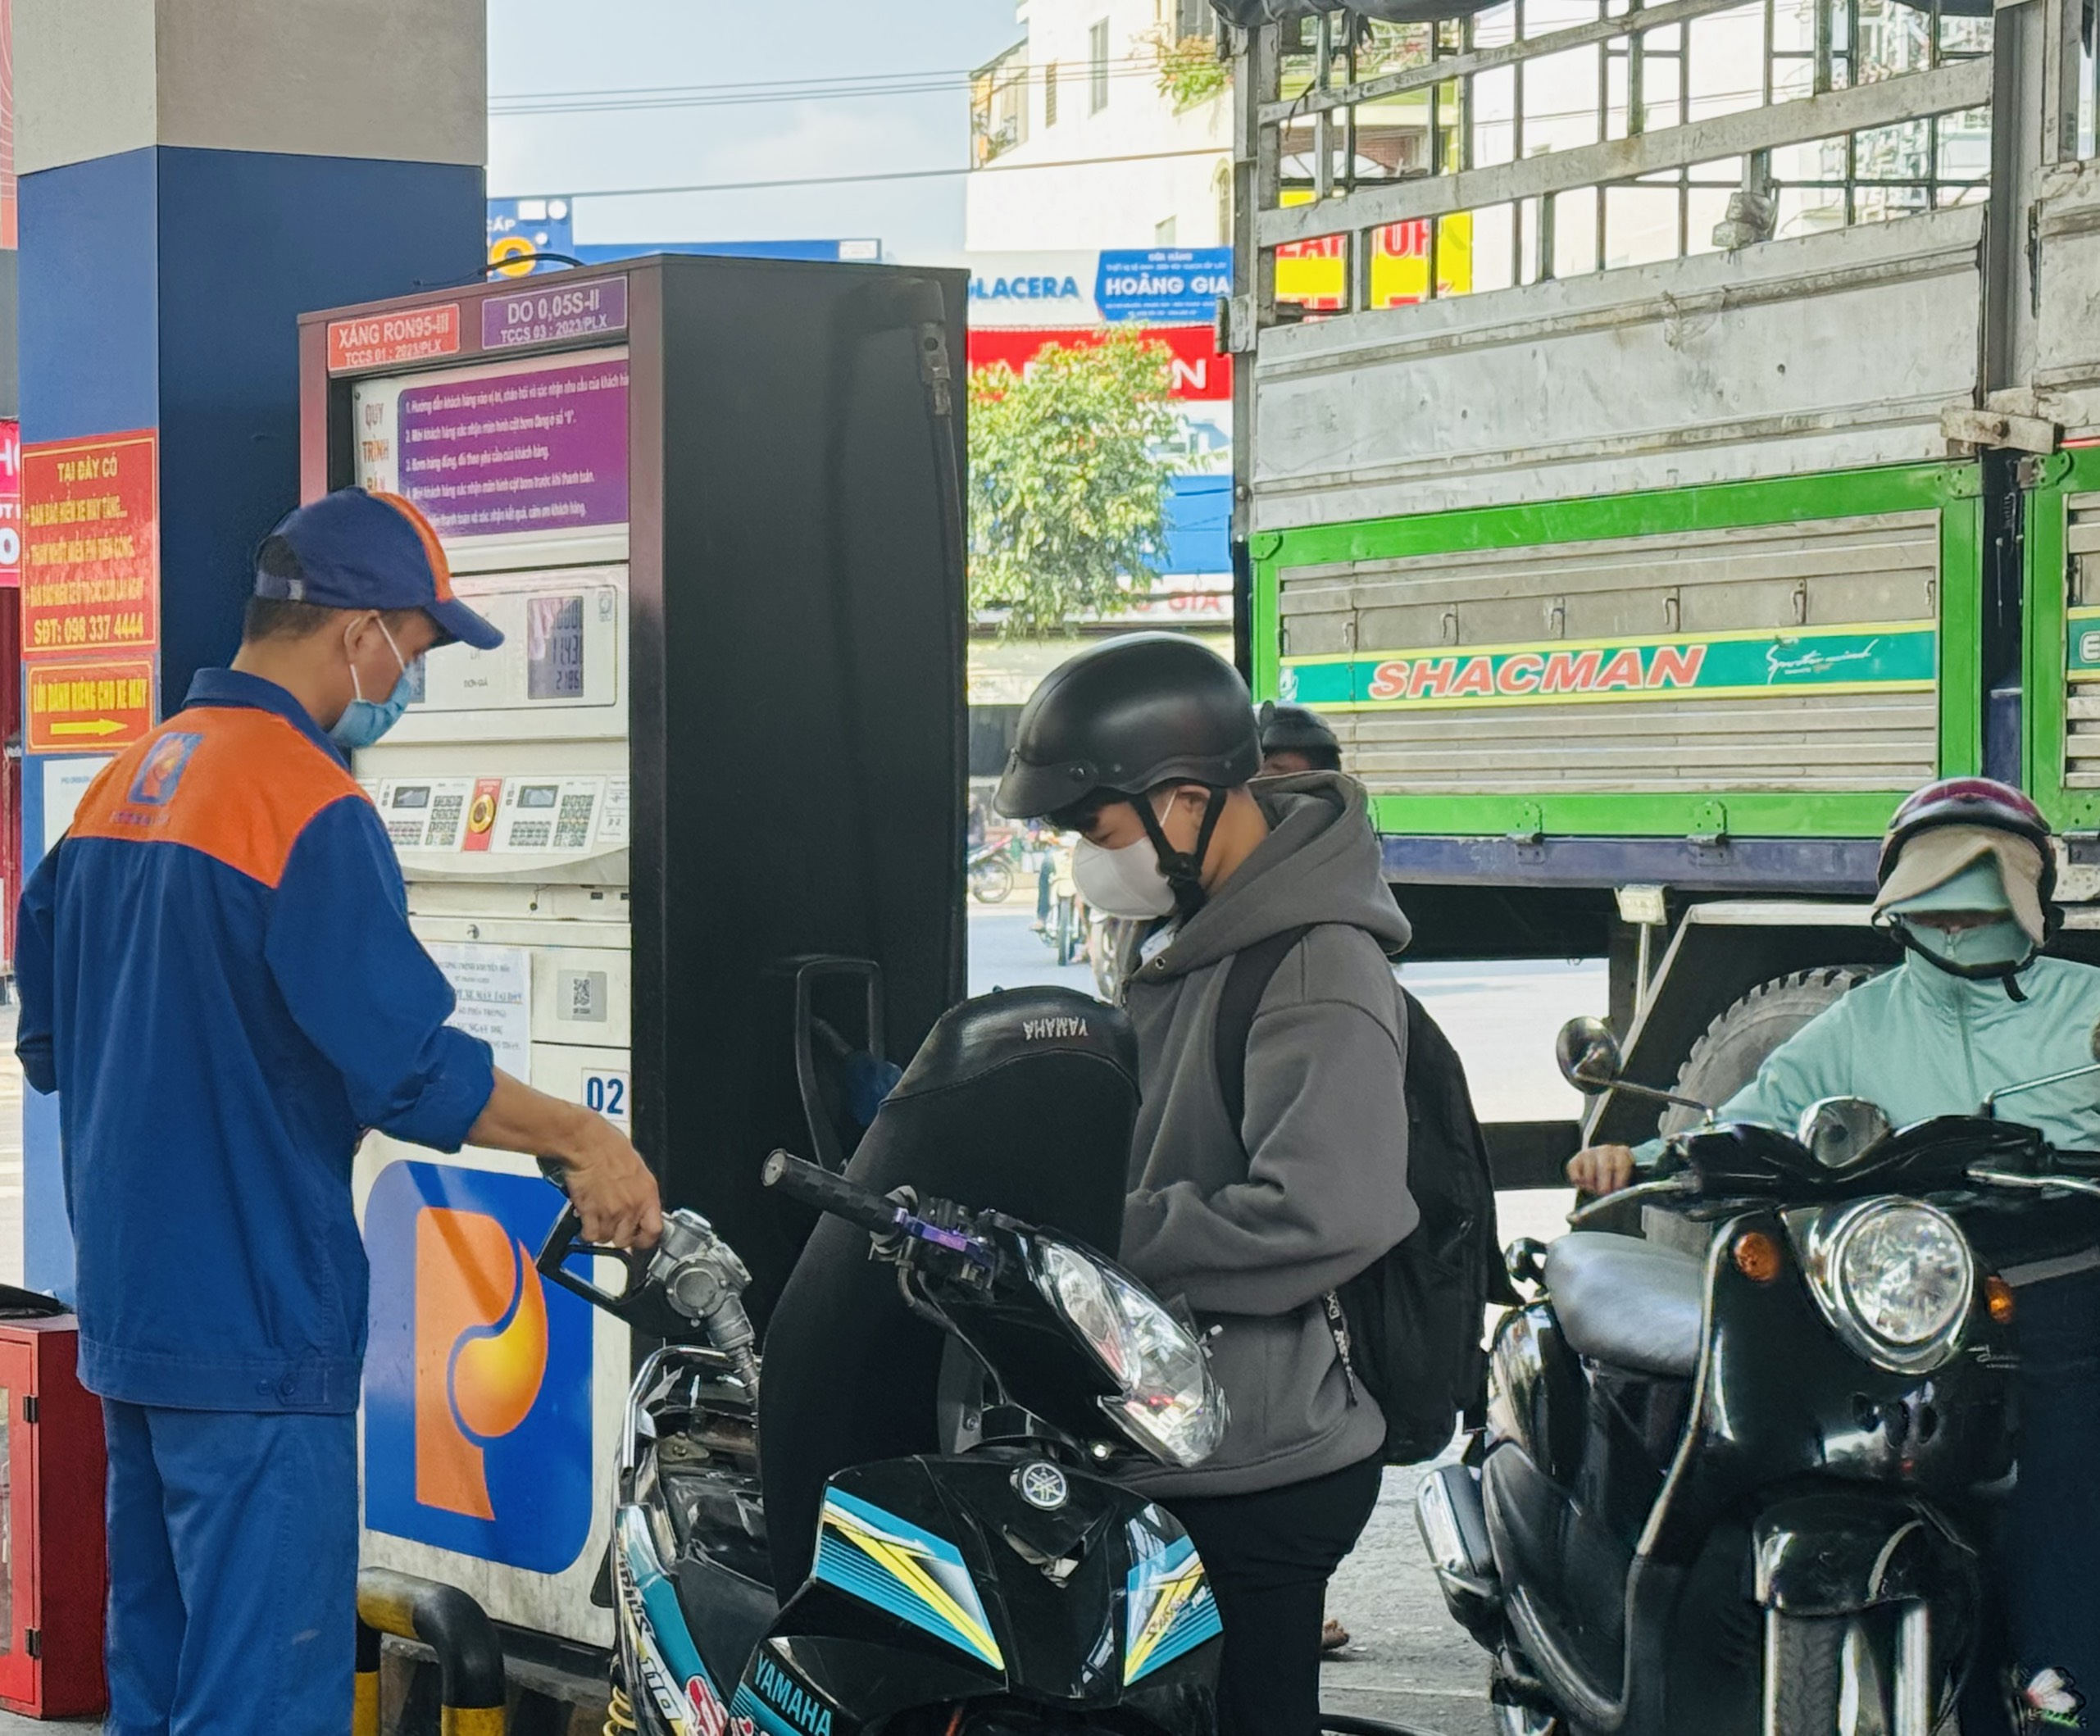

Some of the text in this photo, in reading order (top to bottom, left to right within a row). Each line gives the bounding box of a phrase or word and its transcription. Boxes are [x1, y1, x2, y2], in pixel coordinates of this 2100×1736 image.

[1105, 272, 1186, 296] HOÀNG
[1190, 275, 1230, 295] GIA
[507, 288, 599, 325] DO 0,05S-II
[500, 326, 531, 343] TCCS
[89, 614, 111, 641] 337
[114, 611, 143, 639] 4444
[1368, 645, 1707, 700] SHACMAN
[1023, 1016, 1089, 1041] YAMAHA
[586, 1077, 624, 1115] 02
[754, 1651, 832, 1736] YAMAHA
